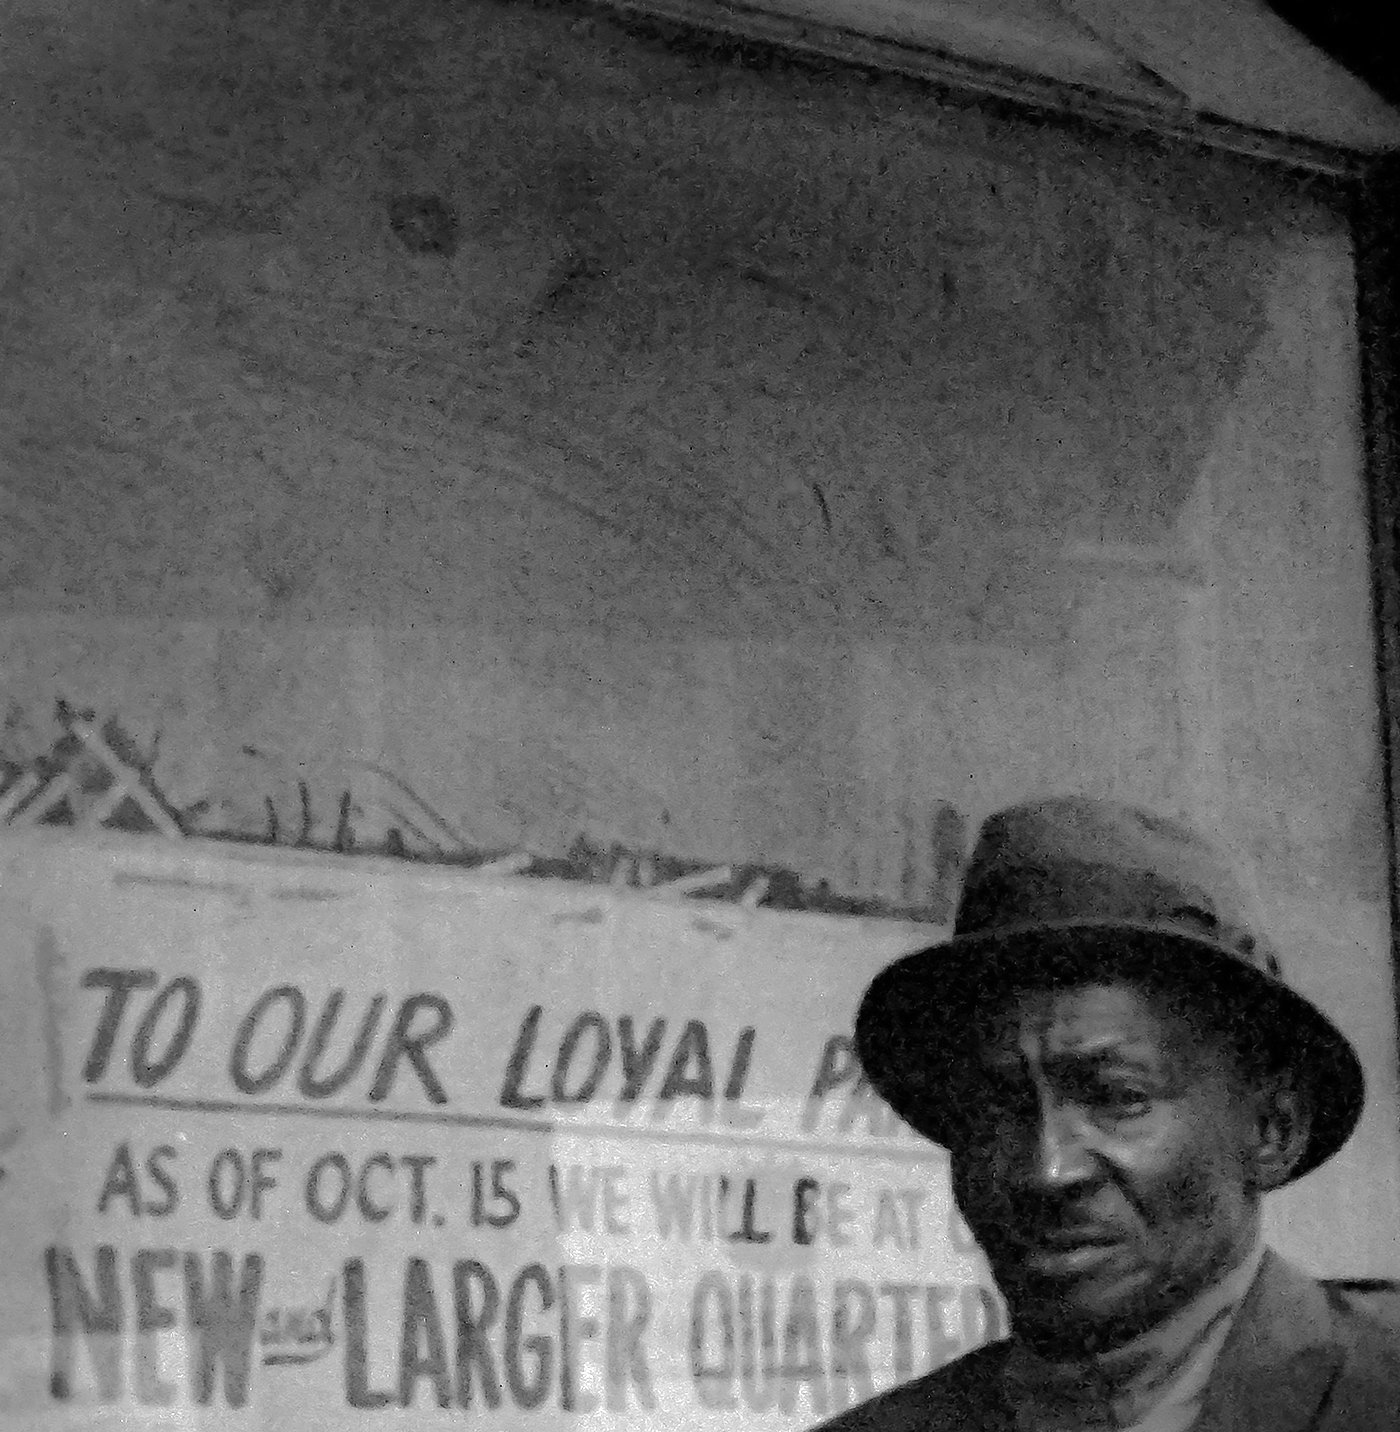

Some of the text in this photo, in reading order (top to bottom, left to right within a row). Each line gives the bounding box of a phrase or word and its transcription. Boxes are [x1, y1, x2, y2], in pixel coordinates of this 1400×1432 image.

[80, 966, 902, 1138] TO OUR LOYAL PA
[97, 1141, 181, 1218] AS
[207, 1147, 284, 1221] OF
[304, 1150, 446, 1227] OCT.
[470, 1160, 521, 1231] 15
[548, 1163, 628, 1237] WE
[650, 1169, 772, 1247] WILL
[792, 1177, 855, 1248] BE
[872, 1186, 928, 1253] AT
[44, 1244, 265, 1409] NEW
[342, 1256, 656, 1414] LARGER
